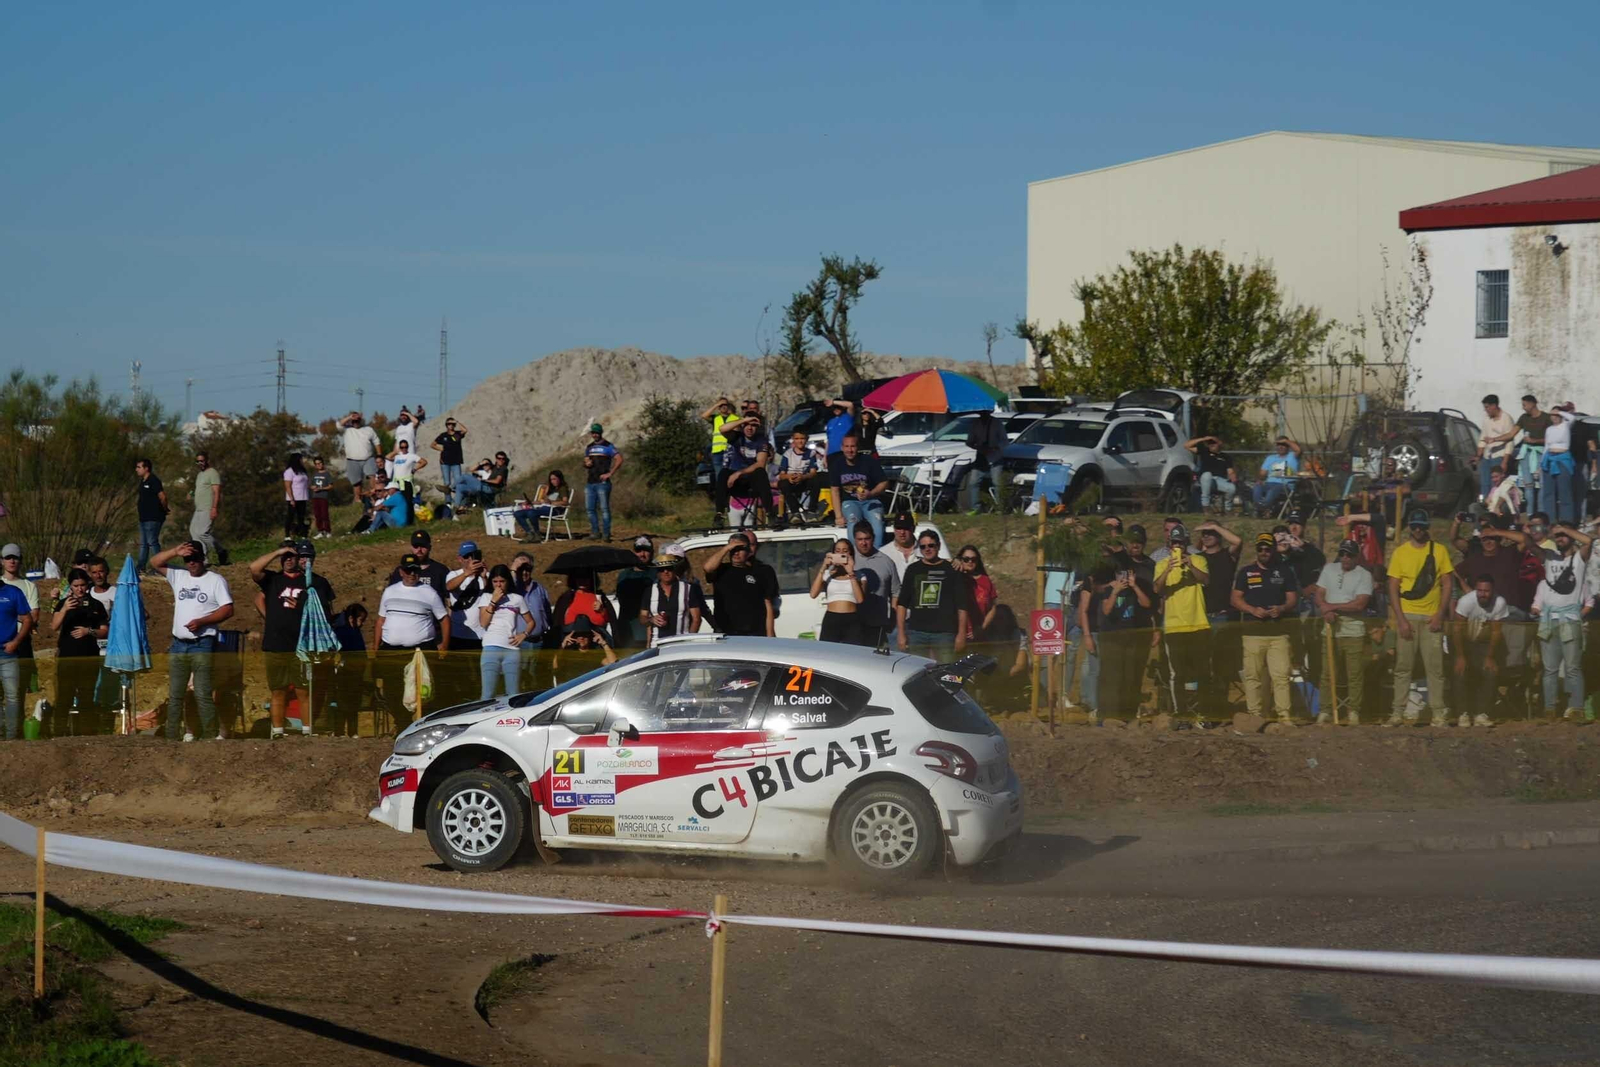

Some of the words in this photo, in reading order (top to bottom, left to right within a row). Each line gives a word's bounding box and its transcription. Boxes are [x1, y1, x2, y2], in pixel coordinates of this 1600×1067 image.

[785, 665, 813, 692] 21
[774, 695, 787, 706] M.
[789, 693, 832, 706] Canedo
[791, 711, 827, 724] Salvat
[555, 749, 580, 774] 21
[596, 760, 653, 769] POZOBLANCO
[569, 823, 613, 835] GETXO
